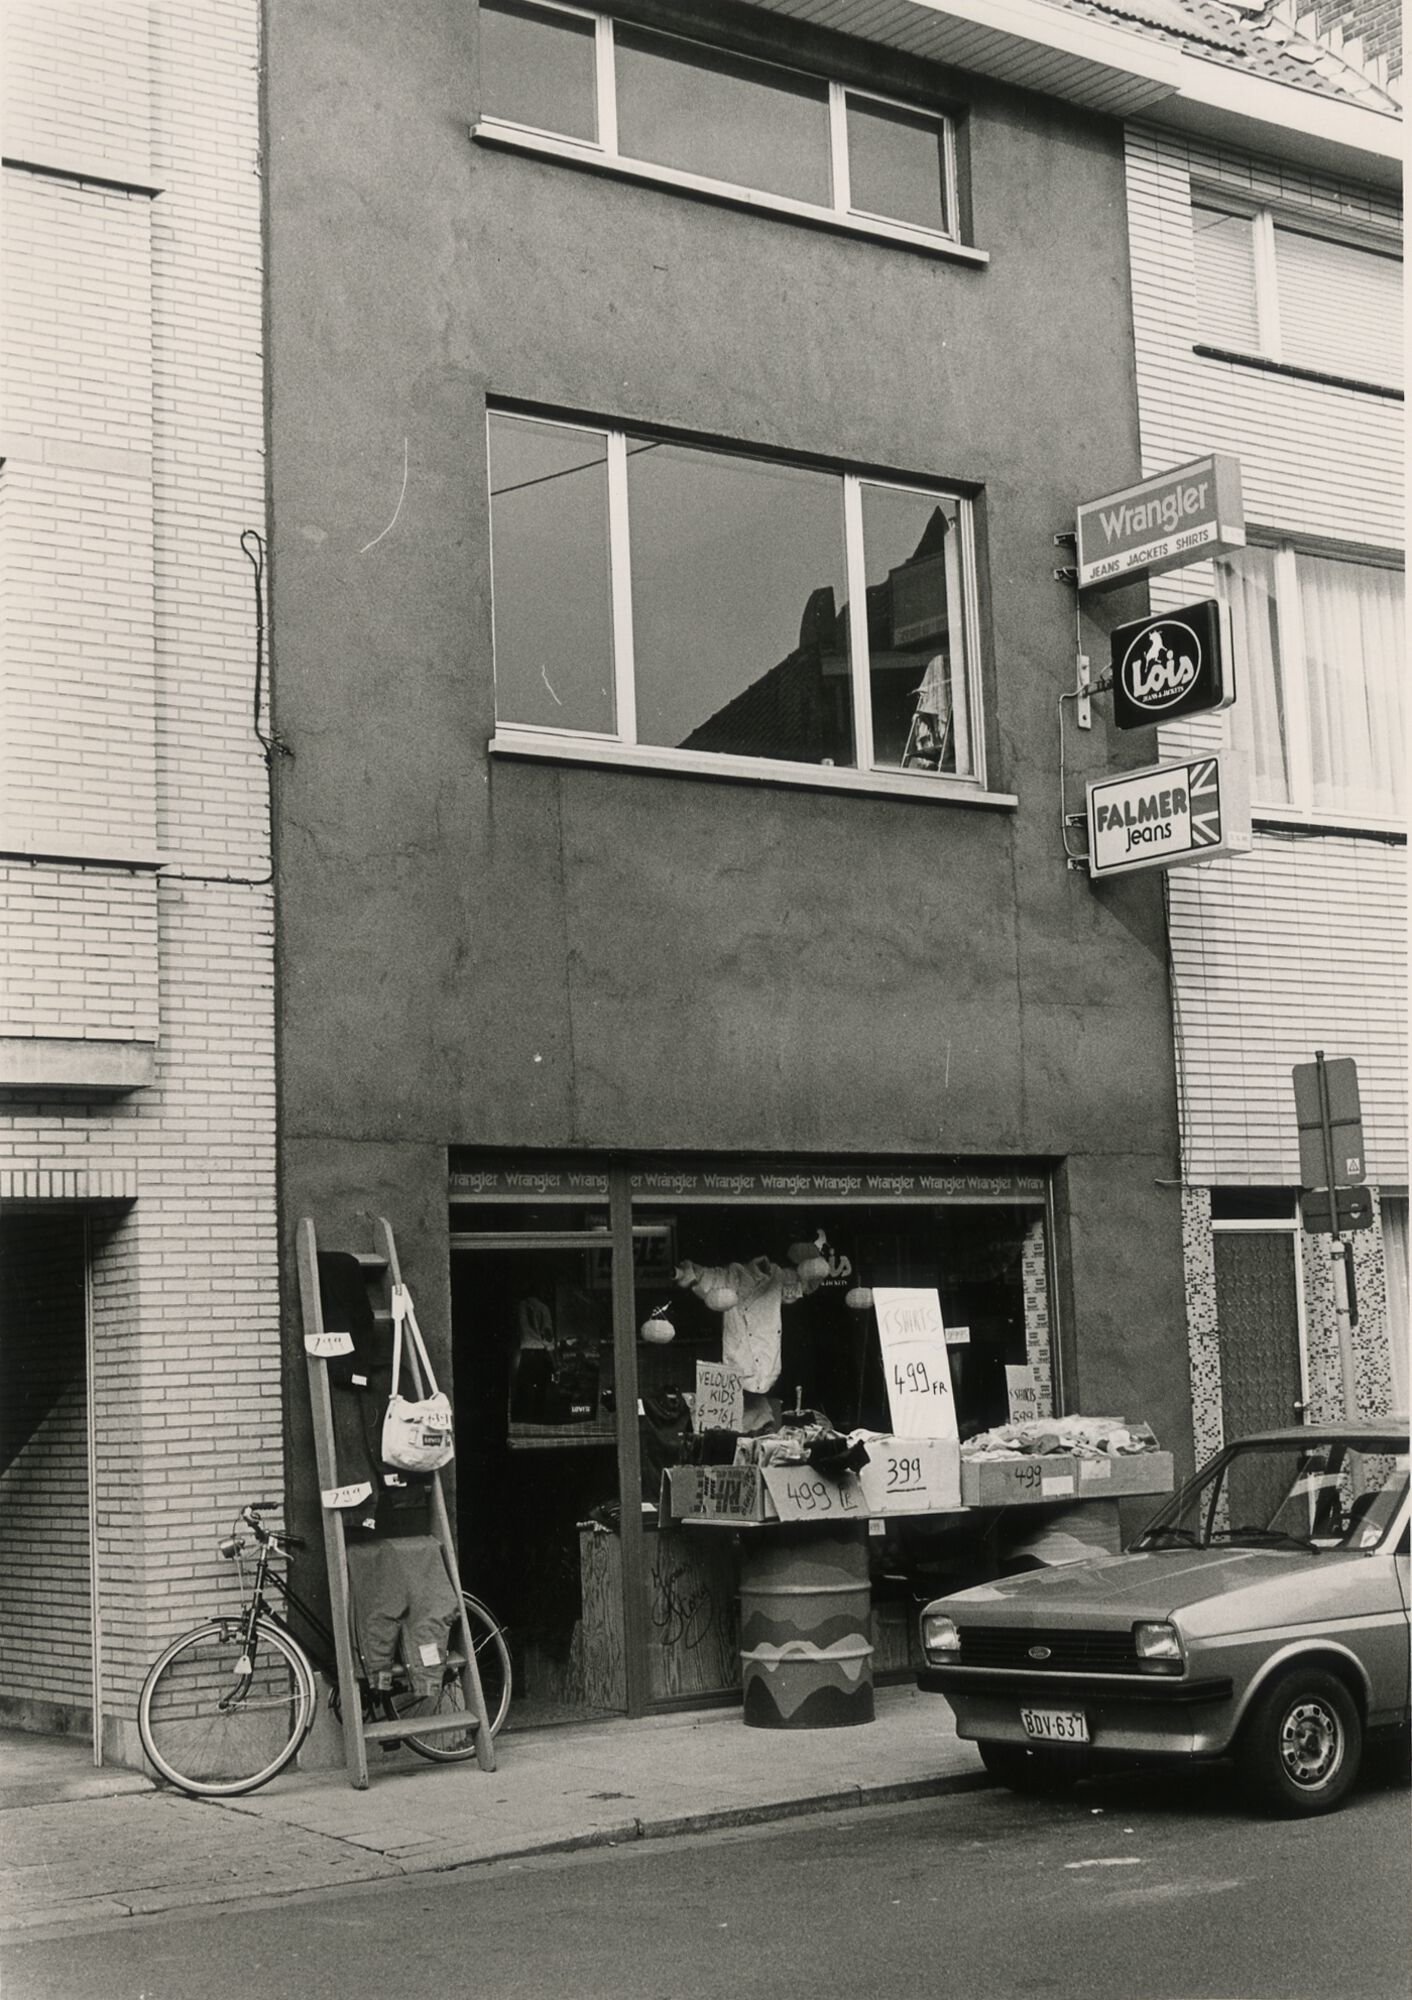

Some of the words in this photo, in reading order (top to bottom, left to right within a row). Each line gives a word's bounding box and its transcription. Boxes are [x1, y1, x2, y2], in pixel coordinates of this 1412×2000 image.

[1100, 481, 1208, 544] Wrangler
[1089, 559, 1120, 579] JEANS
[1126, 543, 1169, 566] JACKETS
[1175, 530, 1209, 550] SHIRTS
[1132, 649, 1194, 698] Lois
[1096, 787, 1188, 833] FALMER
[1125, 822, 1172, 852] jeans
[504, 1171, 561, 1193] Wrangler
[567, 1171, 608, 1193] Wrang
[645, 1172, 698, 1194] Wrangler
[703, 1173, 755, 1194] Wrangler
[760, 1174, 810, 1195] Wrangler
[812, 1174, 862, 1195] Wrangler
[866, 1174, 914, 1195] Wrangler
[919, 1174, 967, 1195] Wrangler
[966, 1175, 1011, 1195] Wrangler
[894, 1307, 939, 1334] SHIRTS
[699, 1371, 742, 1392] VELOURS
[895, 1362, 930, 1395] 499
[932, 1381, 948, 1395] FR
[710, 1389, 735, 1405] KIDS
[1013, 1410, 1034, 1424] 599
[888, 1458, 921, 1487] 399
[1015, 1465, 1042, 1488] 499
[787, 1481, 832, 1510] 499
